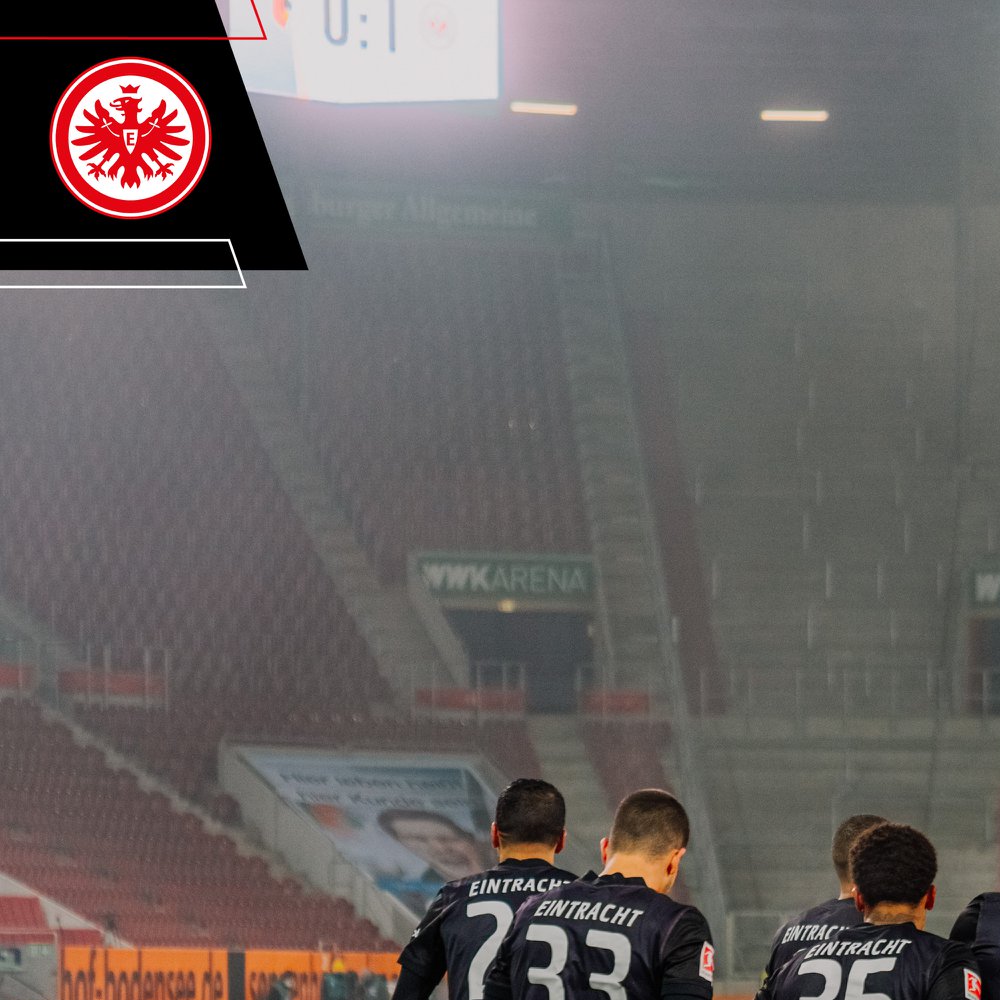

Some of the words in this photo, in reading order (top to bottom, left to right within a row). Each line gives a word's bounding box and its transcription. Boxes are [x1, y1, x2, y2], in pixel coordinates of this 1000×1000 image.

[468, 878, 571, 898] EINTRACH
[534, 899, 645, 928] EINTRACHT
[781, 924, 850, 945] EINTRAC
[803, 938, 913, 960] EINTRACHT
